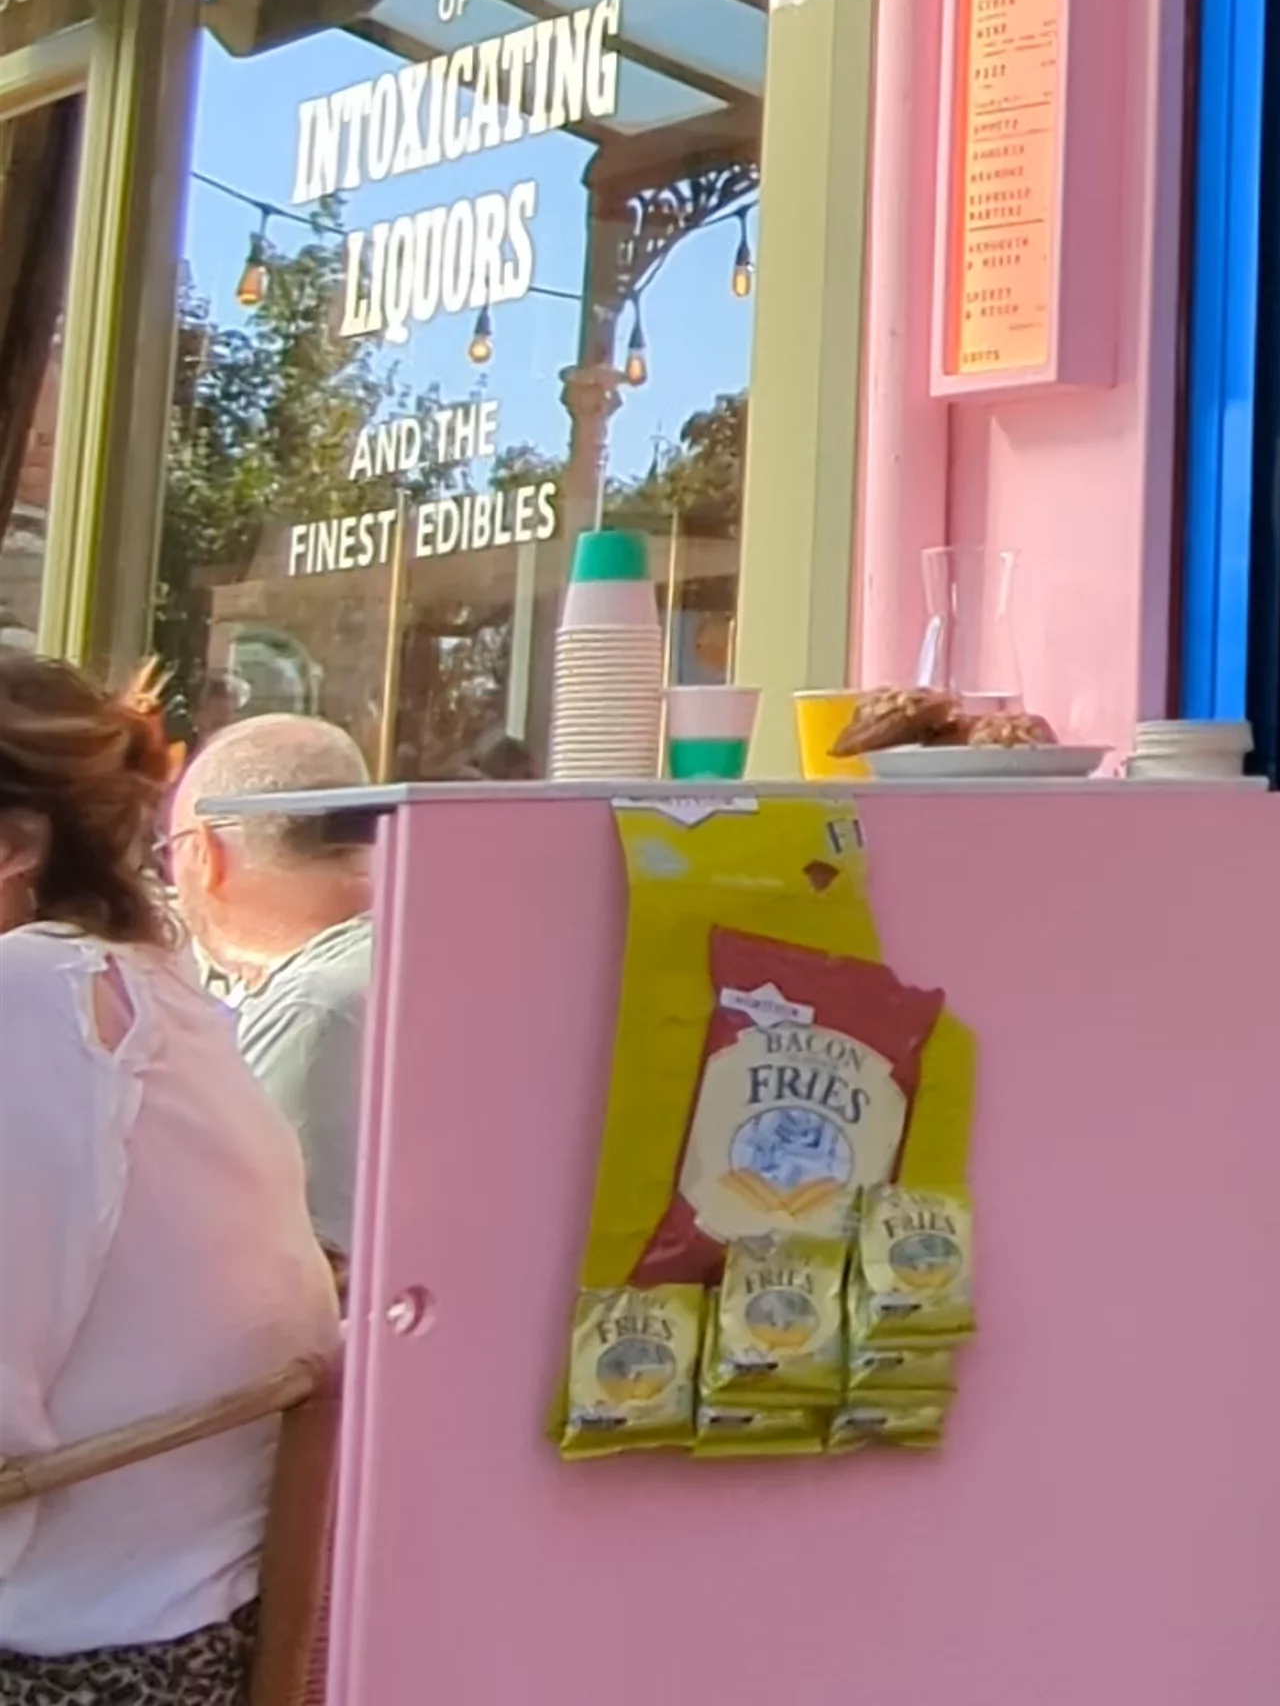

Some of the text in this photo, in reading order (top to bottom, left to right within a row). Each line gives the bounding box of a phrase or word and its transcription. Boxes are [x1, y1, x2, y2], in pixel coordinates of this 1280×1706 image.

[339, 180, 537, 345] LIQUORS
[350, 399, 500, 481] AND THE
[288, 483, 558, 576] FINEST EDIBLES
[766, 1031, 868, 1072] BACON
[748, 1063, 871, 1124] FRIES
